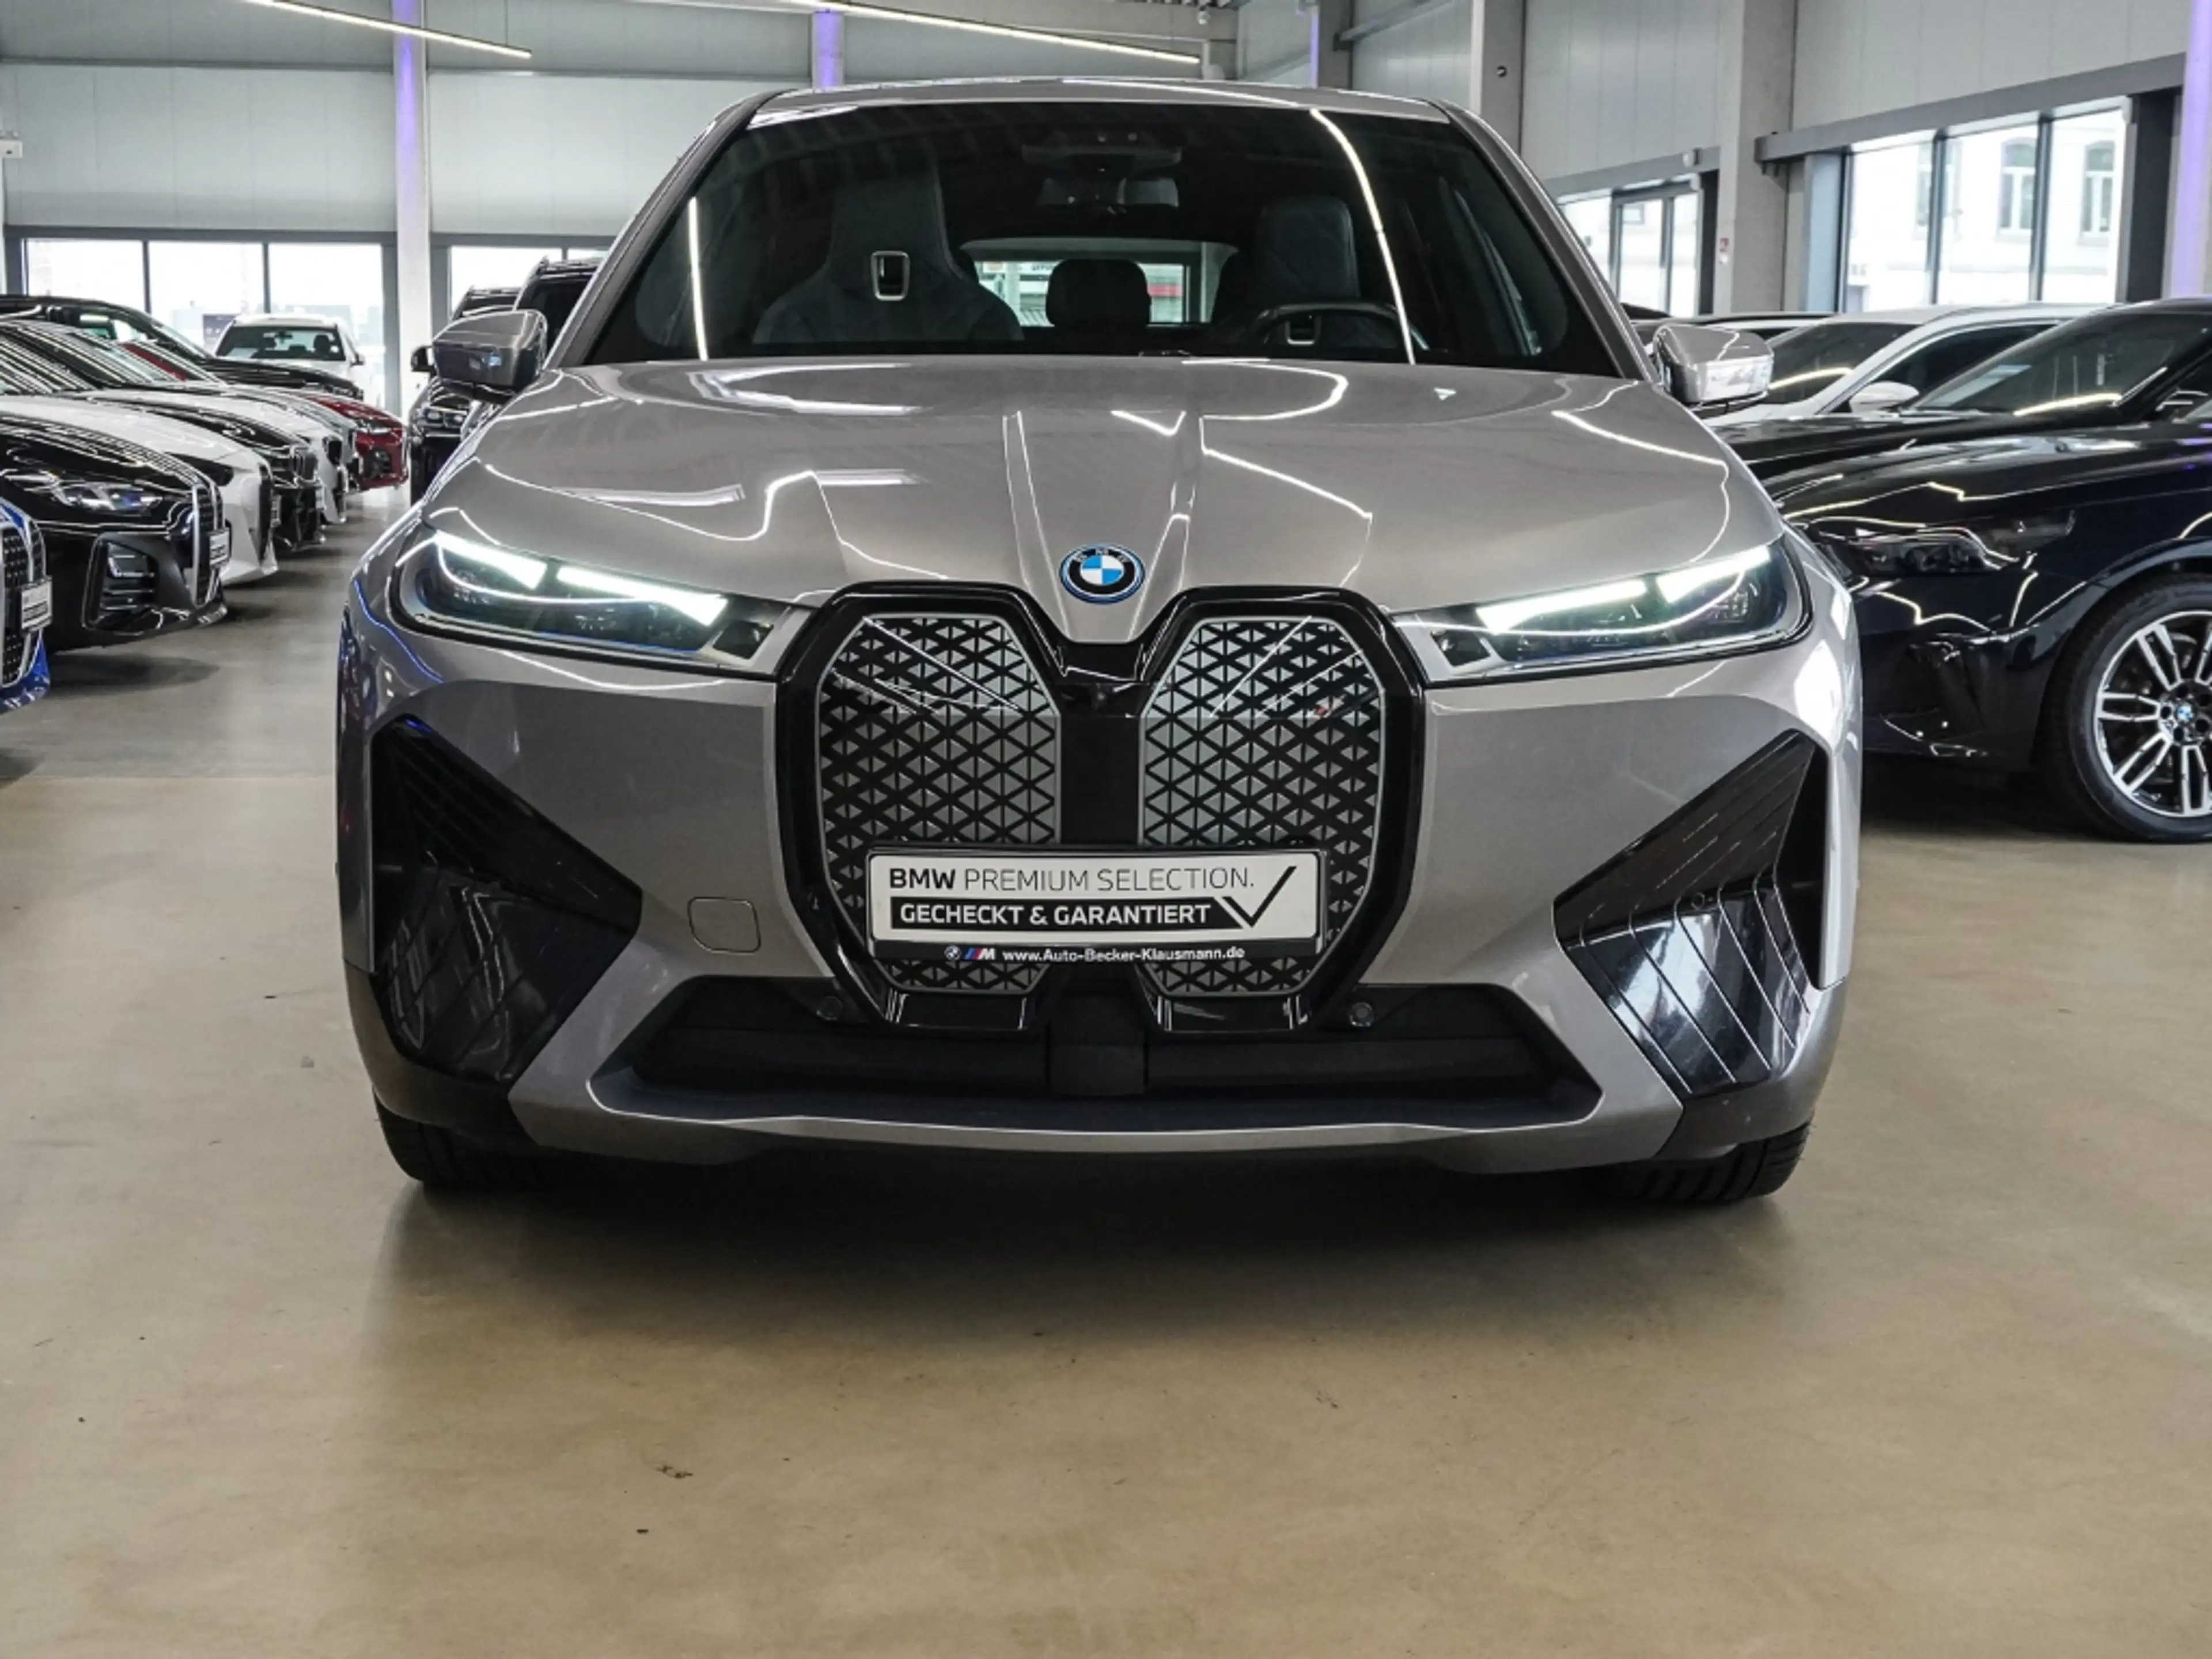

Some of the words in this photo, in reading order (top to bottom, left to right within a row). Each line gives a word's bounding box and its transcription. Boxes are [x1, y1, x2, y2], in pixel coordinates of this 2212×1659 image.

[889, 868, 956, 889] BMW
[964, 869, 1089, 891] PREMIUM
[1097, 866, 1254, 891] SELECTION.
[900, 903, 1025, 925] GECHECKT
[1029, 906, 1049, 926] &
[1053, 904, 1211, 926] GARANTIERT
[1002, 946, 1245, 963] www.Auto-Becker-Klausmann.de
